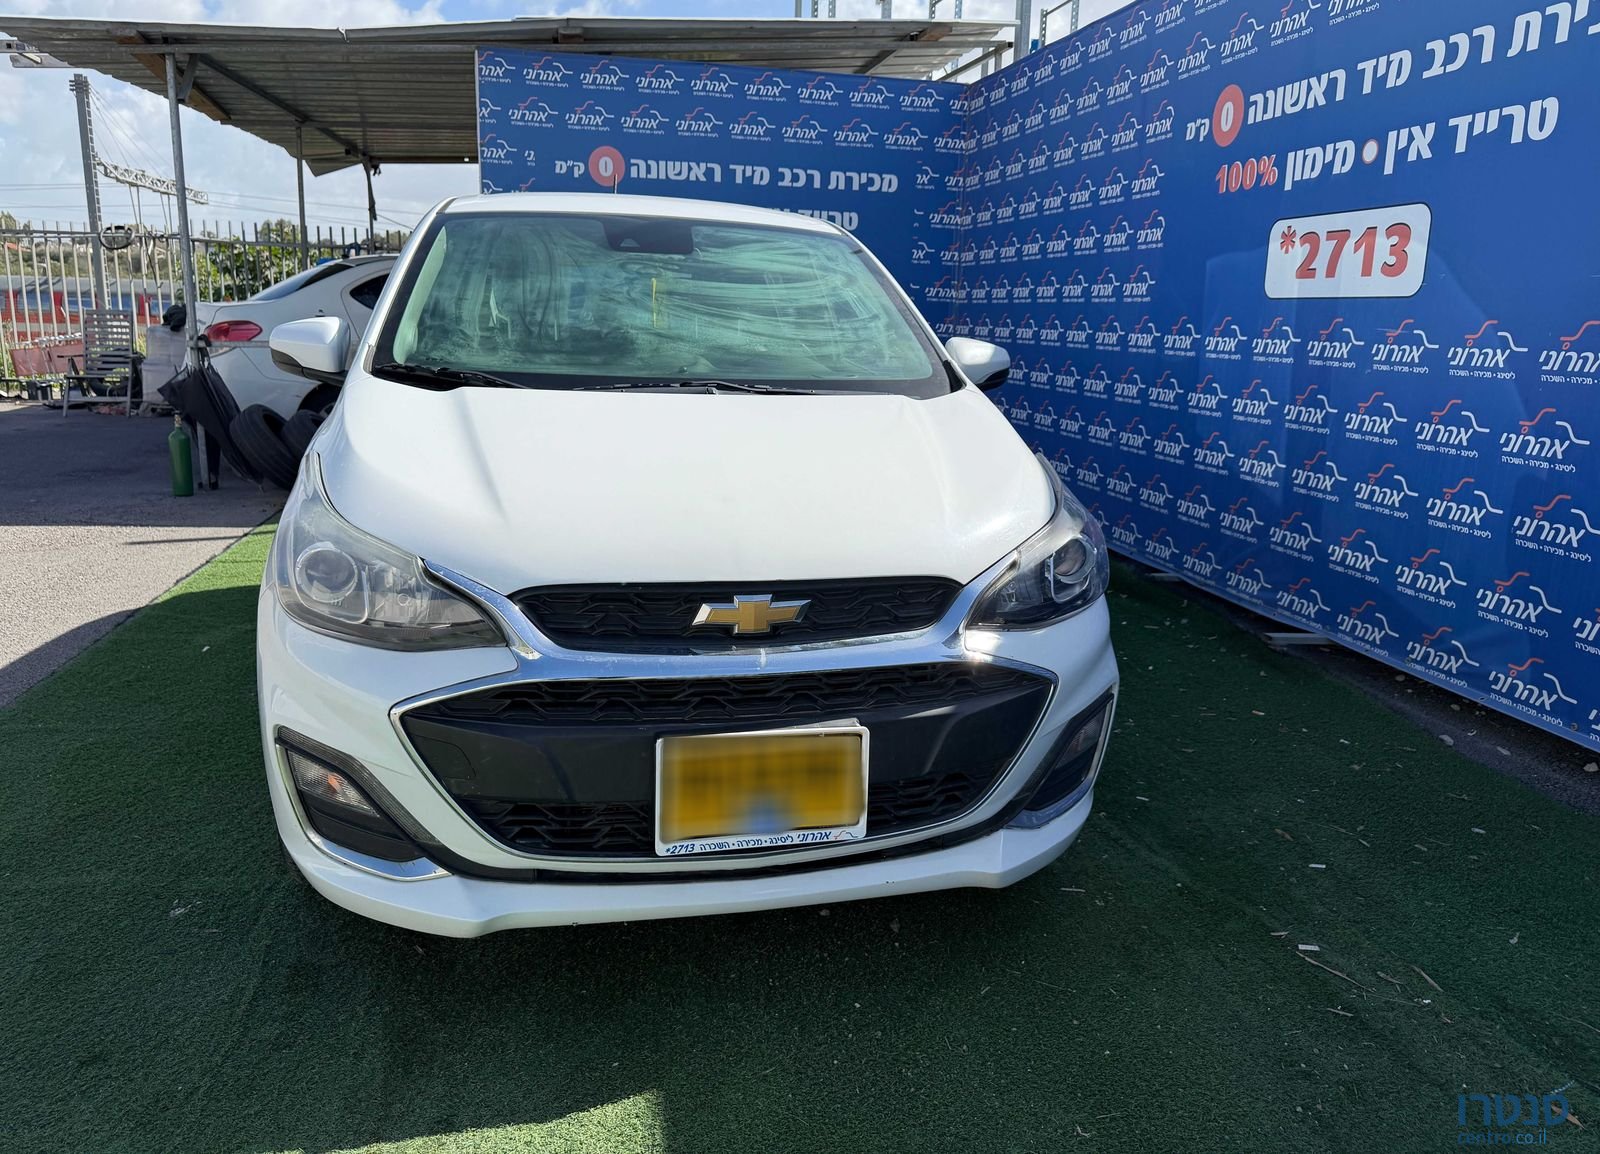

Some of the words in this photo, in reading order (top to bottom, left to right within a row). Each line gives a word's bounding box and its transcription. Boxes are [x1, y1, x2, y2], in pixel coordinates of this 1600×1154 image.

[1270, 7, 1310, 38] אהרוני
[1507, 0, 1600, 57] ירת
[1220, 29, 1255, 57] אהרוני
[1422, 25, 1496, 79] רכב
[1177, 48, 1207, 74] אהרוני
[1356, 49, 1412, 94] מיד
[523, 67, 563, 81] אהרוני
[580, 71, 619, 85] אהרוני
[636, 75, 675, 89] אהרוני
[691, 78, 729, 91] אהרוני
[744, 83, 782, 97] אהרוני
[797, 86, 834, 100] אהרוני
[849, 90, 886, 104] אהרוני
[899, 94, 936, 108] אהרוני
[1247, 68, 1347, 125] ראשונה
[508, 108, 548, 122] אהרוני
[565, 112, 605, 126] אהרוני
[620, 115, 659, 129] אהרוני
[675, 118, 713, 132] אהרוני
[1220, 101, 1234, 132] 0
[1448, 96, 1559, 154] טרייד
[729, 122, 767, 136] אהרוני
[781, 126, 819, 139] אהרוני
[833, 129, 870, 143] אהרוני
[883, 133, 919, 146] אהרוני
[1383, 122, 1436, 176] אין
[598, 156, 614, 177] 0
[630, 158, 721, 182] ראשונה
[729, 164, 770, 186] מיד
[1215, 153, 1278, 194] 100%
[1284, 139, 1356, 191] מימון
[777, 167, 821, 189] רכב
[828, 170, 899, 193] מכירת
[1205, 335, 1237, 351] אהרוני
[1252, 337, 1290, 354] אהרוני
[1307, 340, 1351, 358] אהרוני
[1372, 343, 1424, 362] אהרוני
[1448, 345, 1510, 367] אהרוני
[1187, 392, 1218, 408] אהרוני
[1232, 398, 1268, 416] אהרוני
[1284, 405, 1325, 424] אהרוני
[1344, 413, 1393, 434] אהרוני
[1415, 422, 1473, 446] אהרוני
[1193, 448, 1225, 466] אהרוני
[1500, 433, 1570, 459] אהרוני
[1239, 457, 1275, 477] אהרוני
[1293, 469, 1335, 491] אהרוני
[1354, 482, 1403, 507] אהרוני
[1219, 512, 1254, 534] אהרוני
[1427, 498, 1486, 526] אהרוני
[1270, 527, 1310, 551] אהרוני
[1514, 516, 1586, 547] אהרוני
[1183, 555, 1213, 577] אהרוני
[1328, 545, 1375, 571] אהרוני
[1226, 571, 1260, 596] אהרוני
[1396, 565, 1451, 595] אהרוני
[1277, 591, 1317, 618] אהרוני
[1477, 588, 1543, 623] אהרוני
[1338, 614, 1385, 644] אהרוני
[1406, 640, 1462, 675] אהרוני
[1489, 670, 1556, 711] אהרוני
[699, 841, 730, 851] השכרה
[736, 839, 763, 847] מכירה
[769, 835, 794, 844] ליסינג
[796, 831, 832, 842] אהרוני
